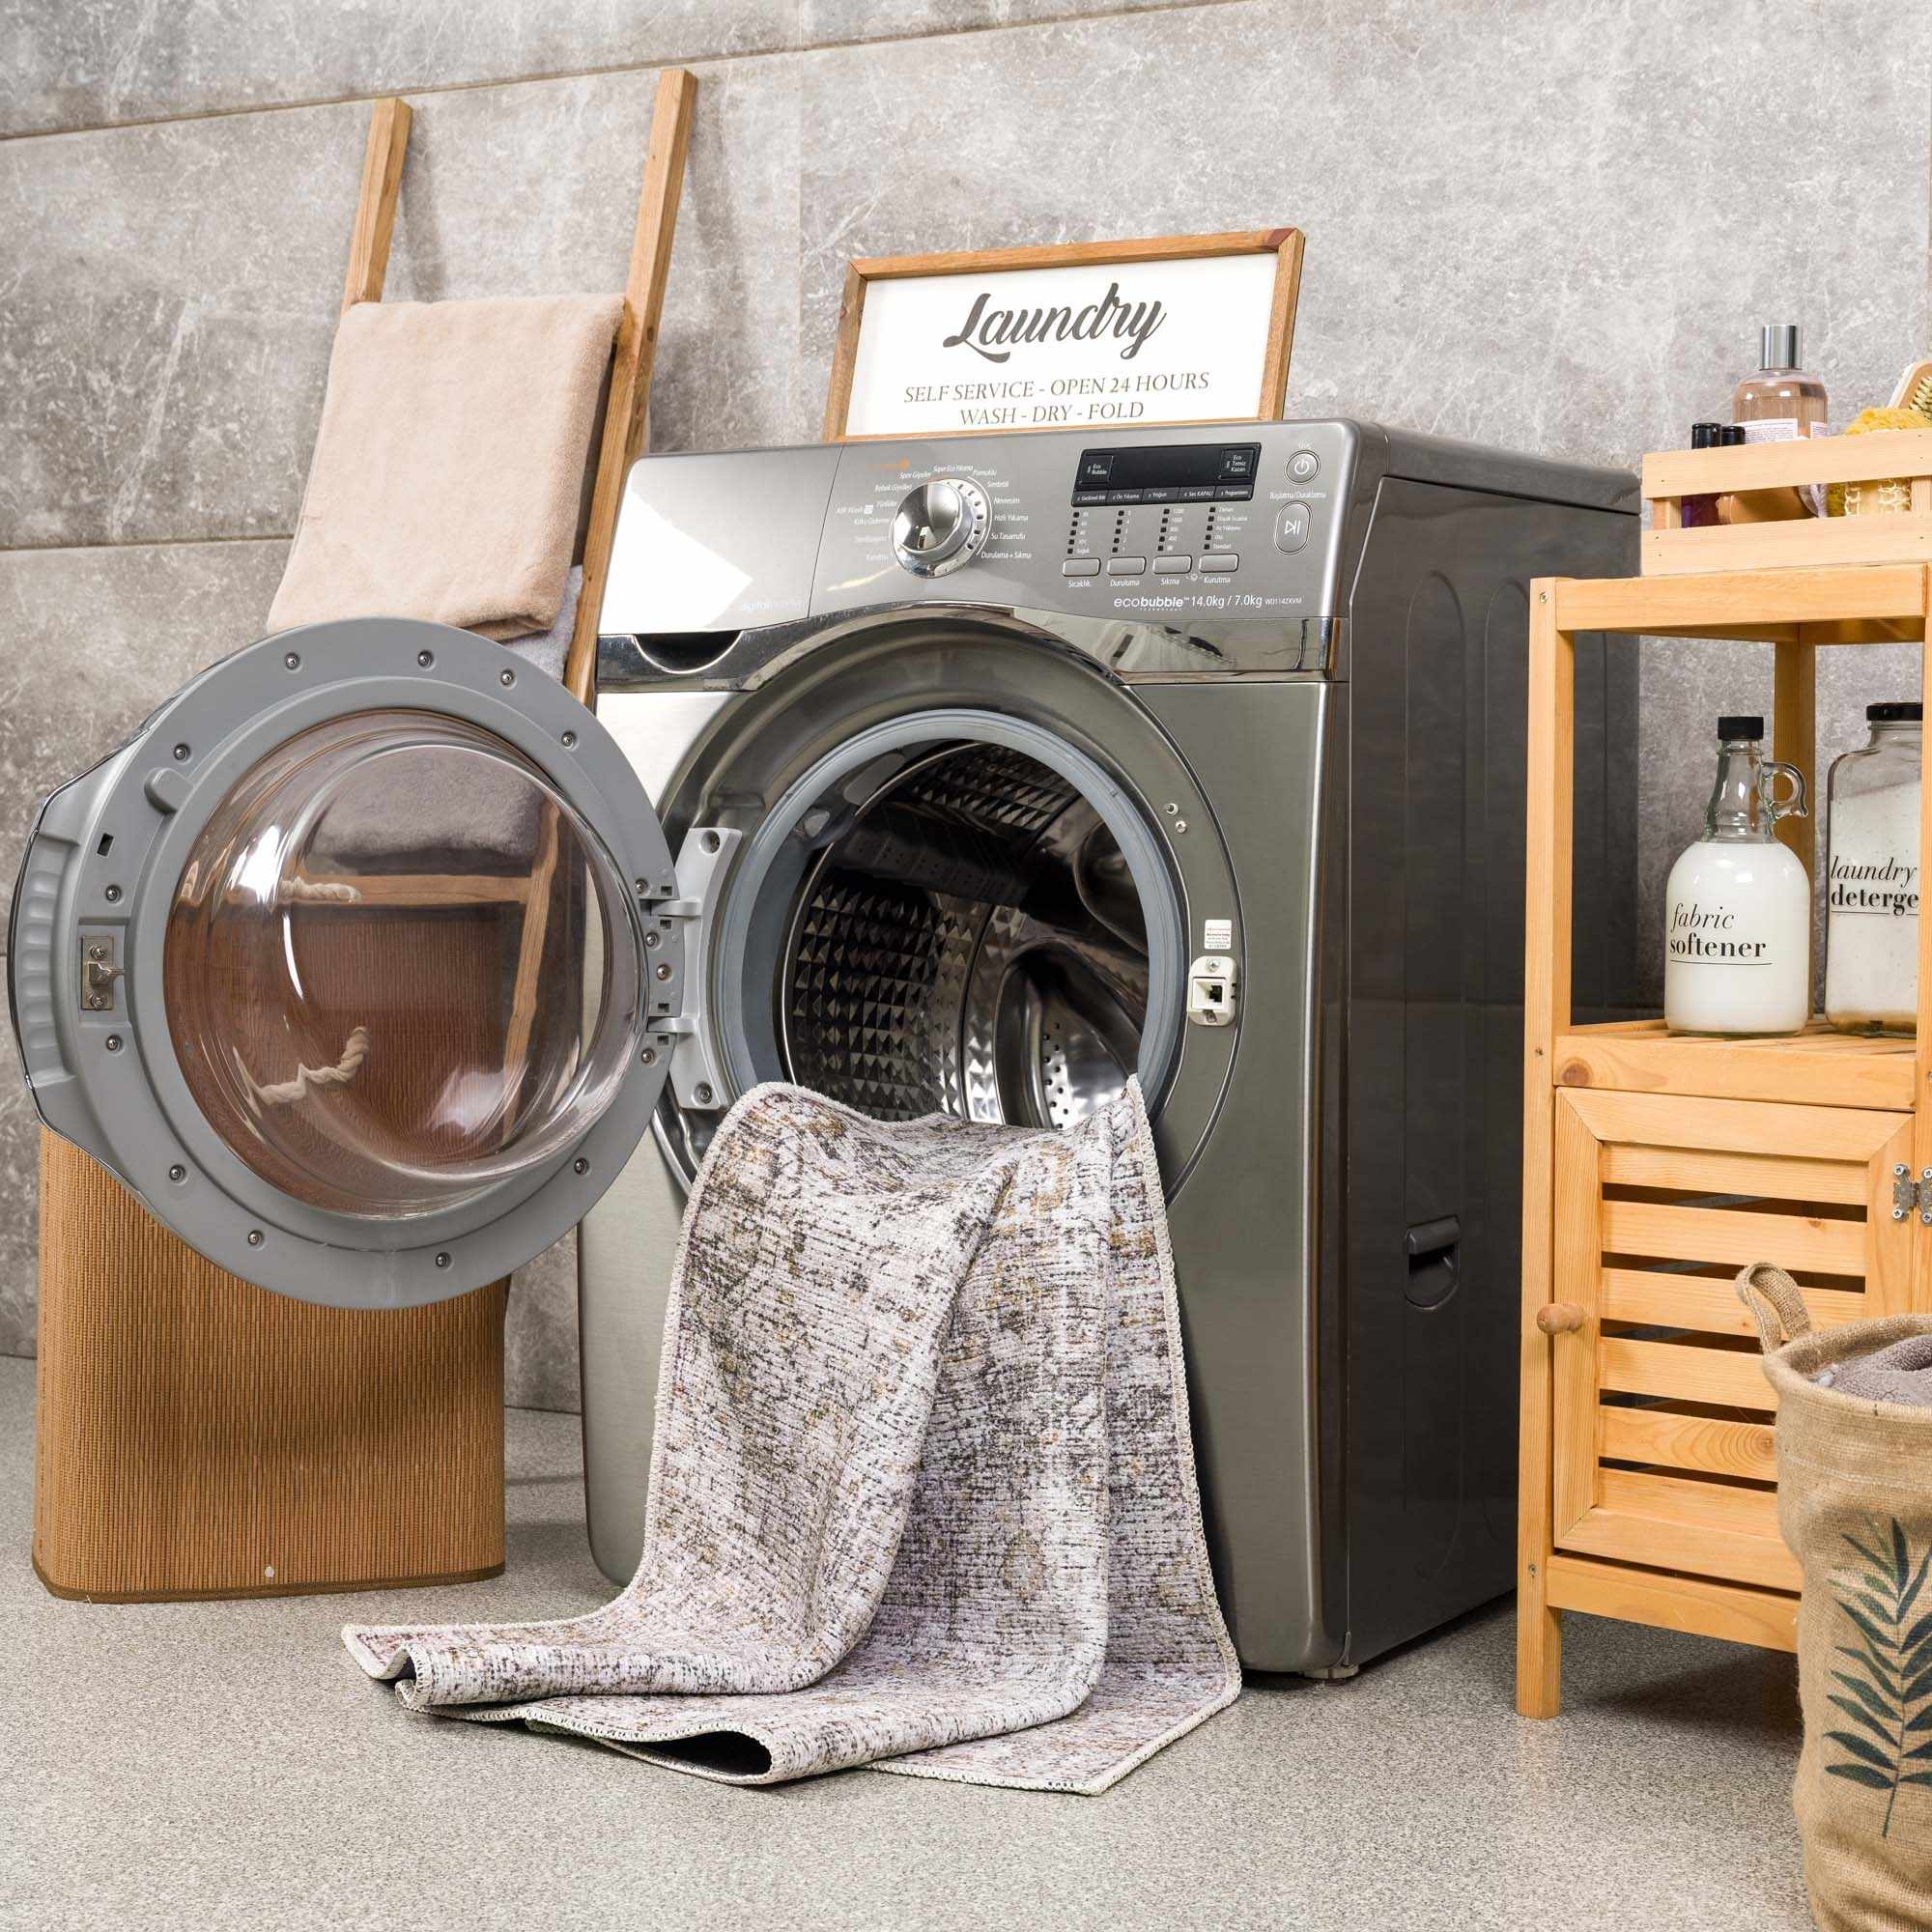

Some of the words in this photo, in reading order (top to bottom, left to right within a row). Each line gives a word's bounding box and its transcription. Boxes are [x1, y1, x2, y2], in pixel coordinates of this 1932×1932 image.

[943, 282, 1168, 364] Laundry
[903, 385, 950, 403] SELF
[952, 381, 1035, 401] SERVICE
[1050, 378, 1106, 396] OPEN
[1110, 376, 1130, 393] 24
[1136, 371, 1210, 392] HOURS
[959, 408, 1017, 425] WASH
[1032, 404, 1073, 423] DRY
[1088, 401, 1145, 419] FOLD
[1190, 595, 1226, 610] 14.0kg
[1235, 593, 1263, 609] 7.0kg
[1830, 855, 1918, 889] laundry
[1831, 883, 1919, 917] deterge
[1671, 902, 1735, 931] fabric
[1669, 932, 1767, 957] softener
